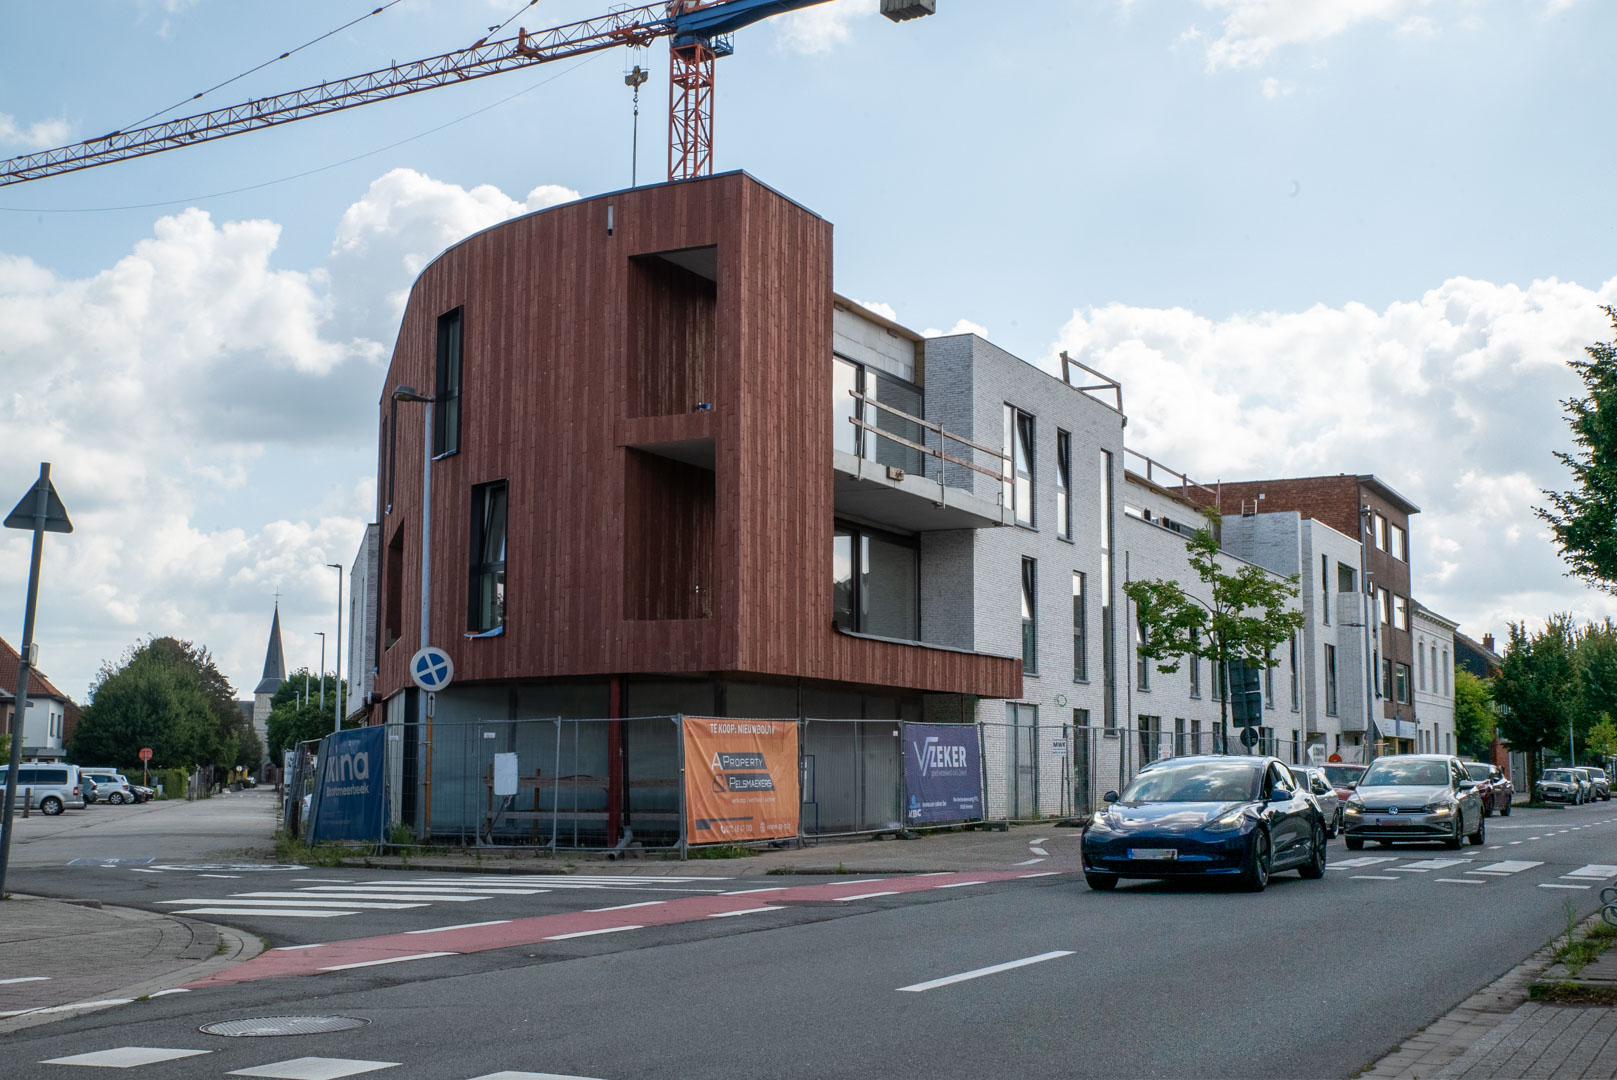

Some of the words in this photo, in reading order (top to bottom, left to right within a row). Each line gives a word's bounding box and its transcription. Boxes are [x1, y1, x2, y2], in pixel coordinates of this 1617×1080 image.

[710, 724, 718, 734] TE
[718, 724, 736, 734] KOOP:
[738, 725, 775, 734] NIEUWBOUW
[711, 752, 723, 771] A
